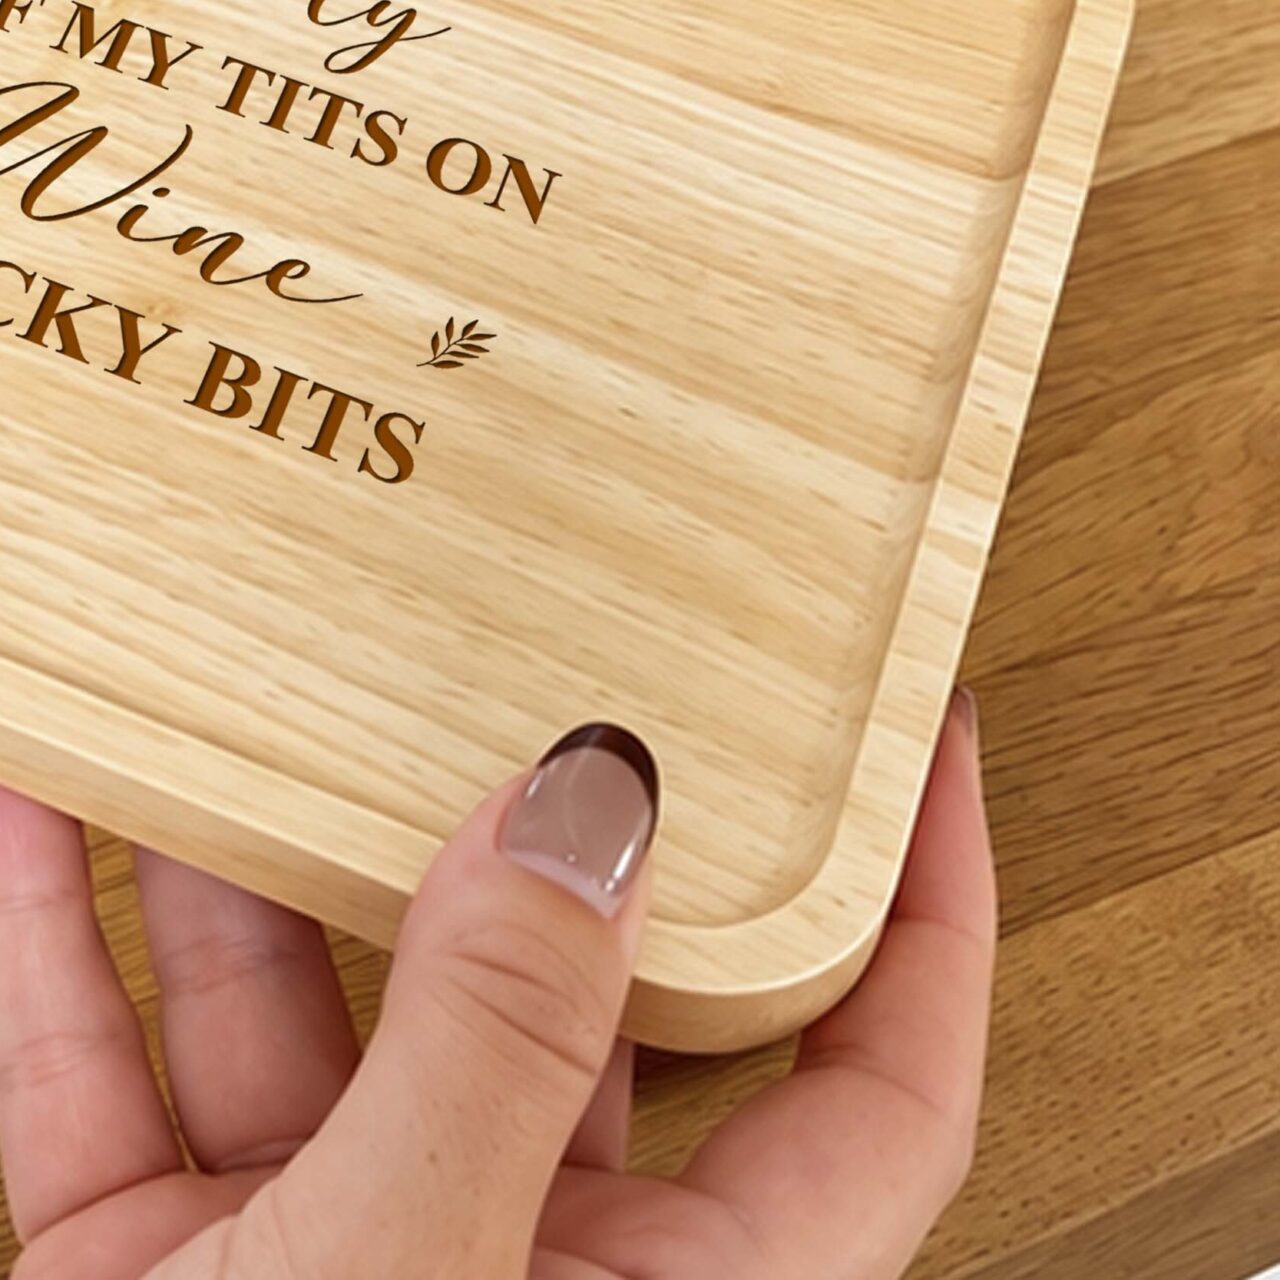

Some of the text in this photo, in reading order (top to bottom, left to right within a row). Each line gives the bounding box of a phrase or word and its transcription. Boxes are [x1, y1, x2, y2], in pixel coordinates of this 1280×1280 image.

[49, 0, 204, 90] MY
[215, 55, 408, 167] TITS
[425, 136, 563, 225] ON
[183, 340, 426, 484] BITS
